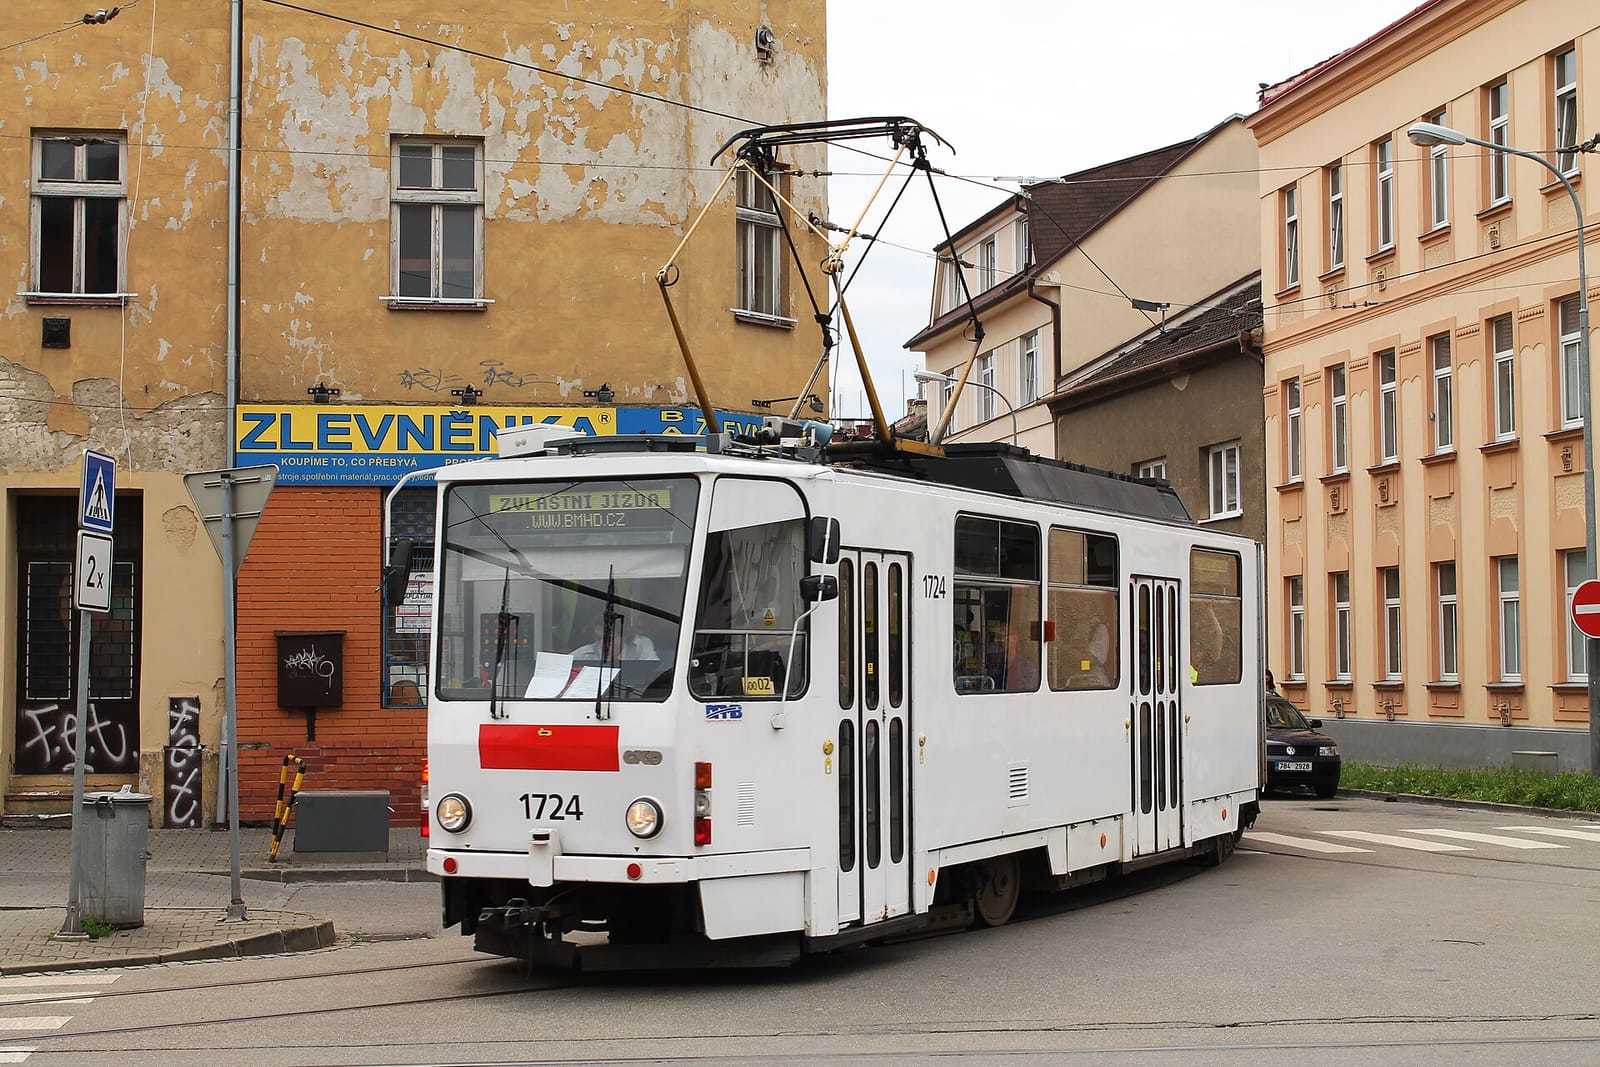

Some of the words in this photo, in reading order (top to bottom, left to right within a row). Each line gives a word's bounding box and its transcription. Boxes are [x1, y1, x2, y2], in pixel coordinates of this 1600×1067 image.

[281, 456, 328, 466] KOUPÍME
[331, 458, 348, 468] TO,
[351, 458, 365, 467] CO
[369, 456, 418, 467] PŘEBÝVÁ
[87, 555, 104, 589] 2x
[922, 574, 946, 599] 1724
[519, 793, 584, 821] 1724
